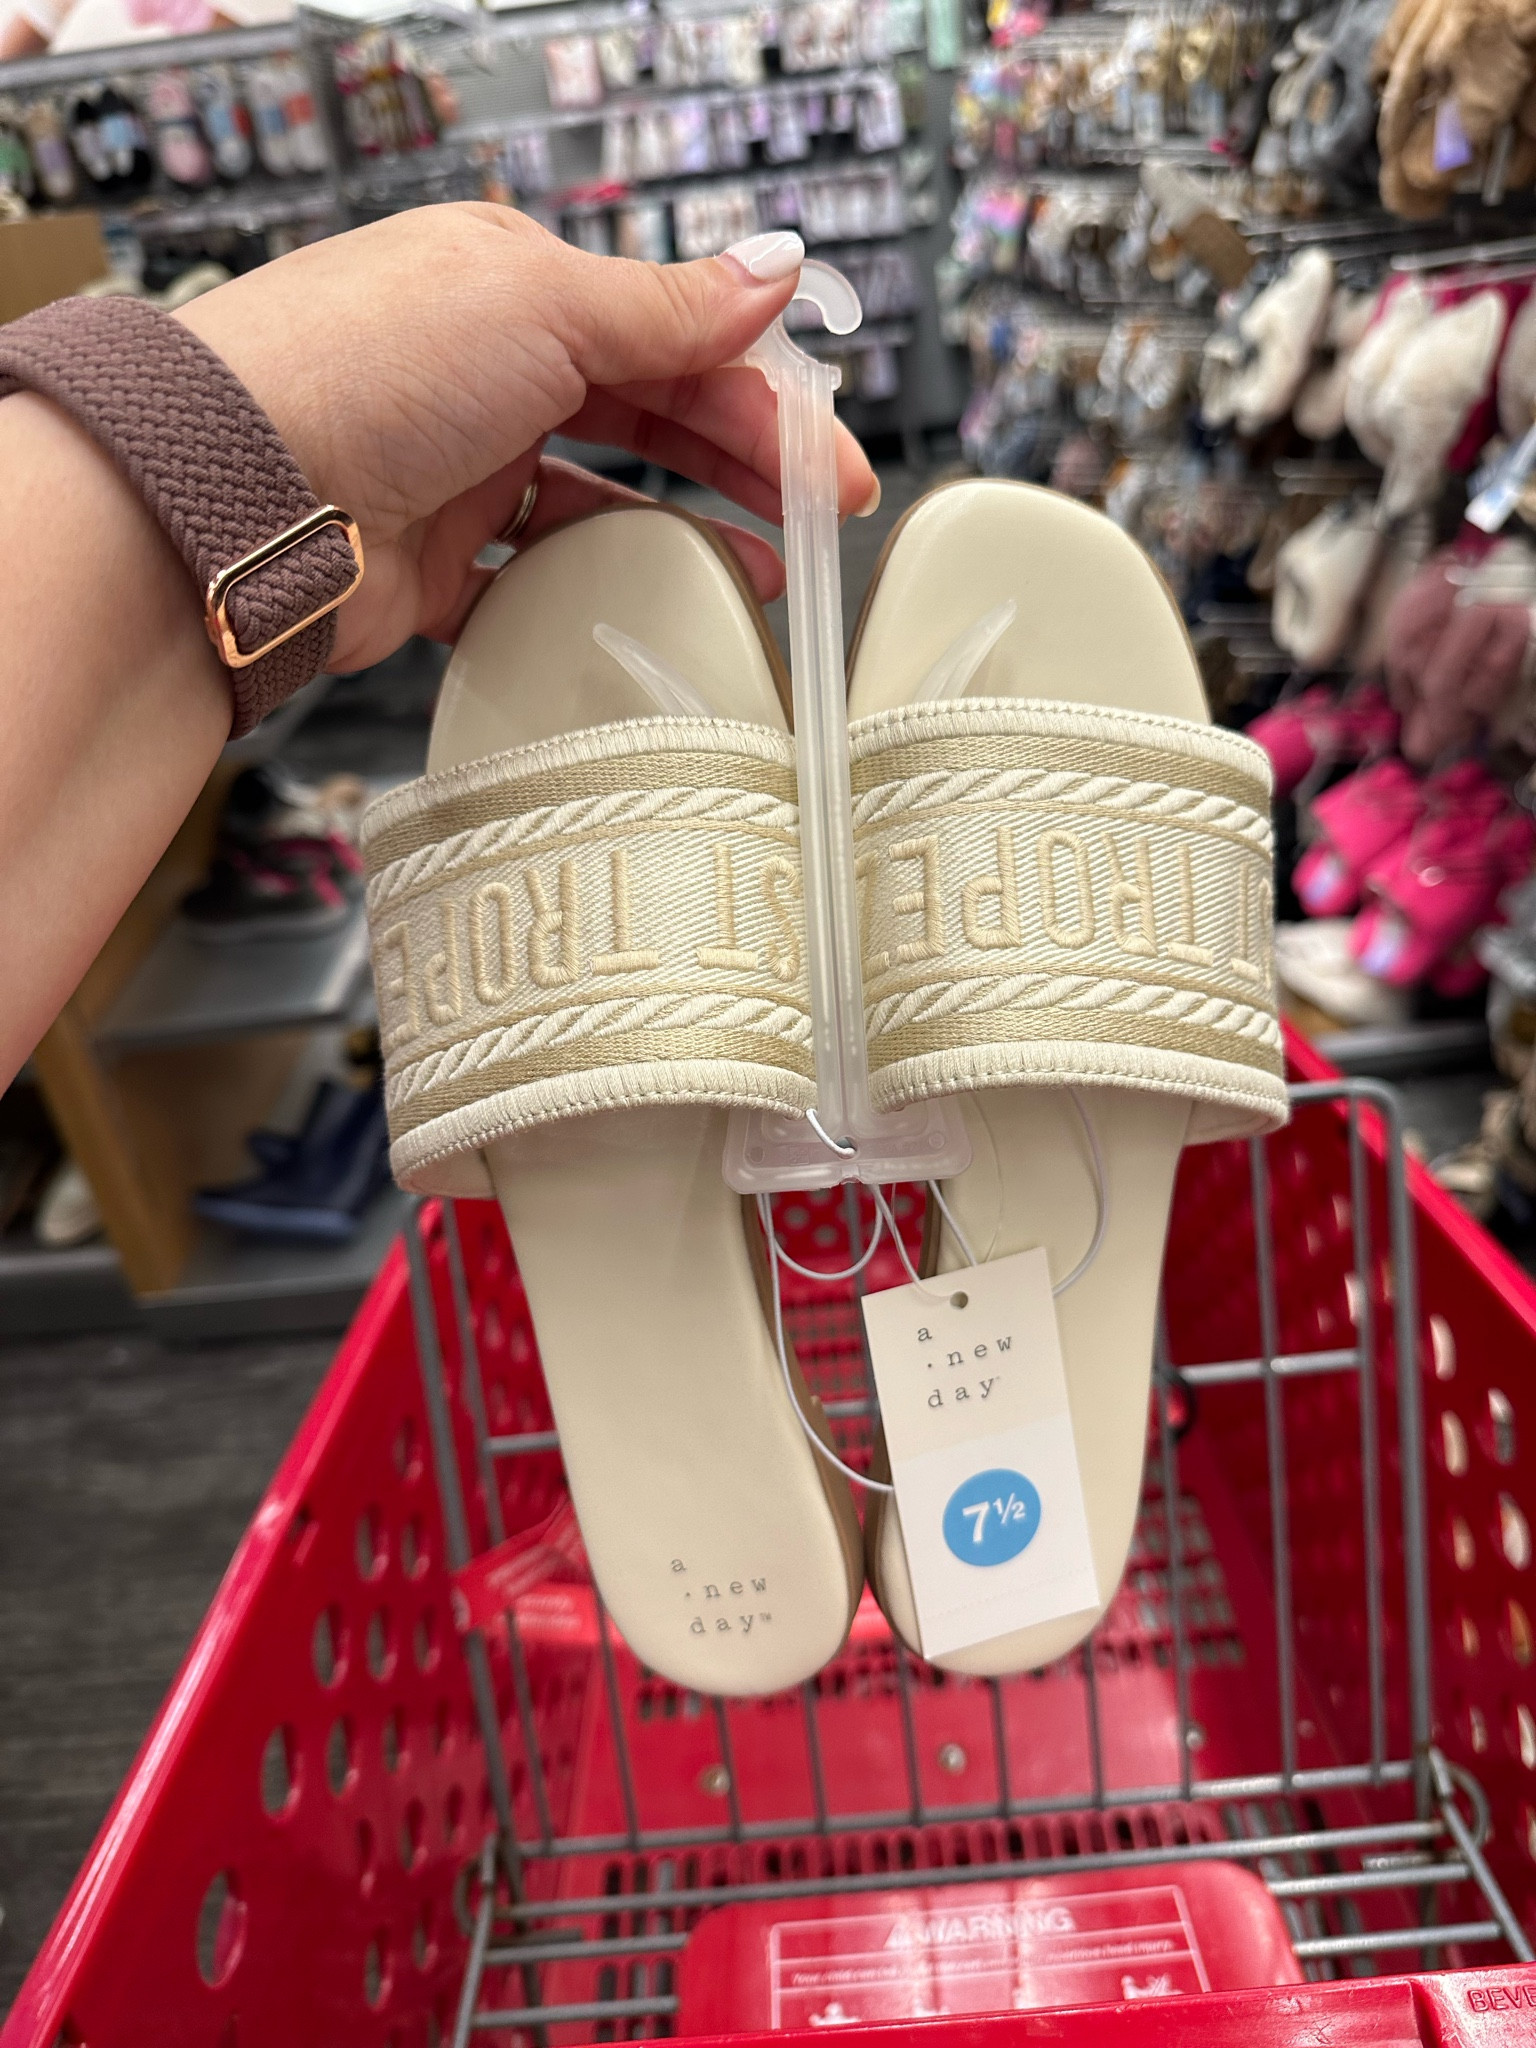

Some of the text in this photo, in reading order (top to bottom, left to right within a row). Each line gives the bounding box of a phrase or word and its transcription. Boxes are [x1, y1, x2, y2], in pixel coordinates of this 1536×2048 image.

[697, 843, 801, 982] ST
[917, 1327, 933, 1342] a
[671, 1558, 687, 1573] a
[910, 1906, 1076, 1945] WARNING
